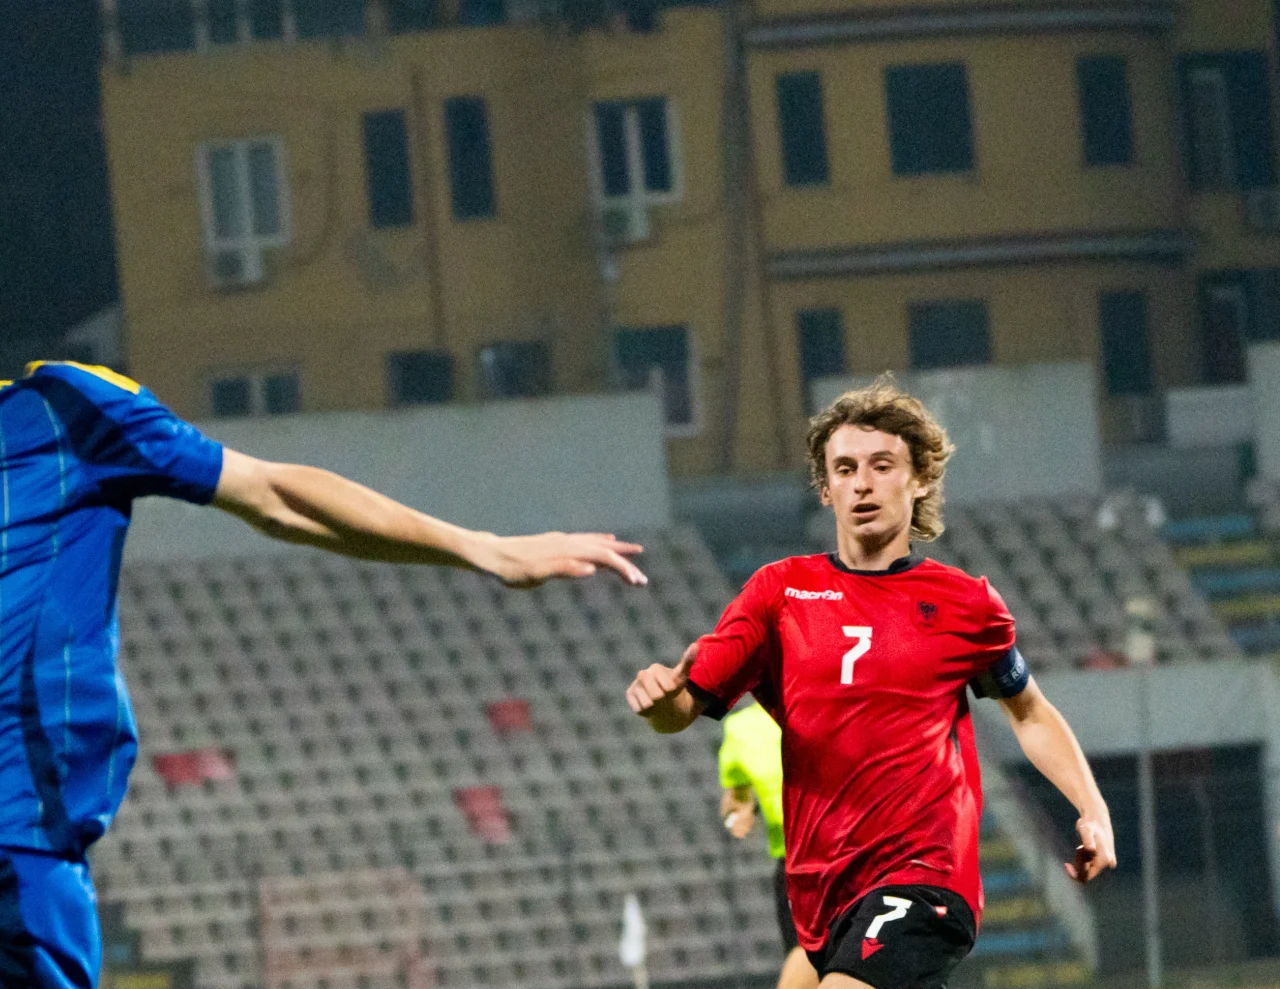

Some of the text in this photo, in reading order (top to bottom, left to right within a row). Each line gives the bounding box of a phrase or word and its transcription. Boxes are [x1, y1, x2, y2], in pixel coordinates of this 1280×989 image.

[784, 586, 843, 601] macron
[840, 625, 873, 685] 7
[865, 895, 913, 939] 7
